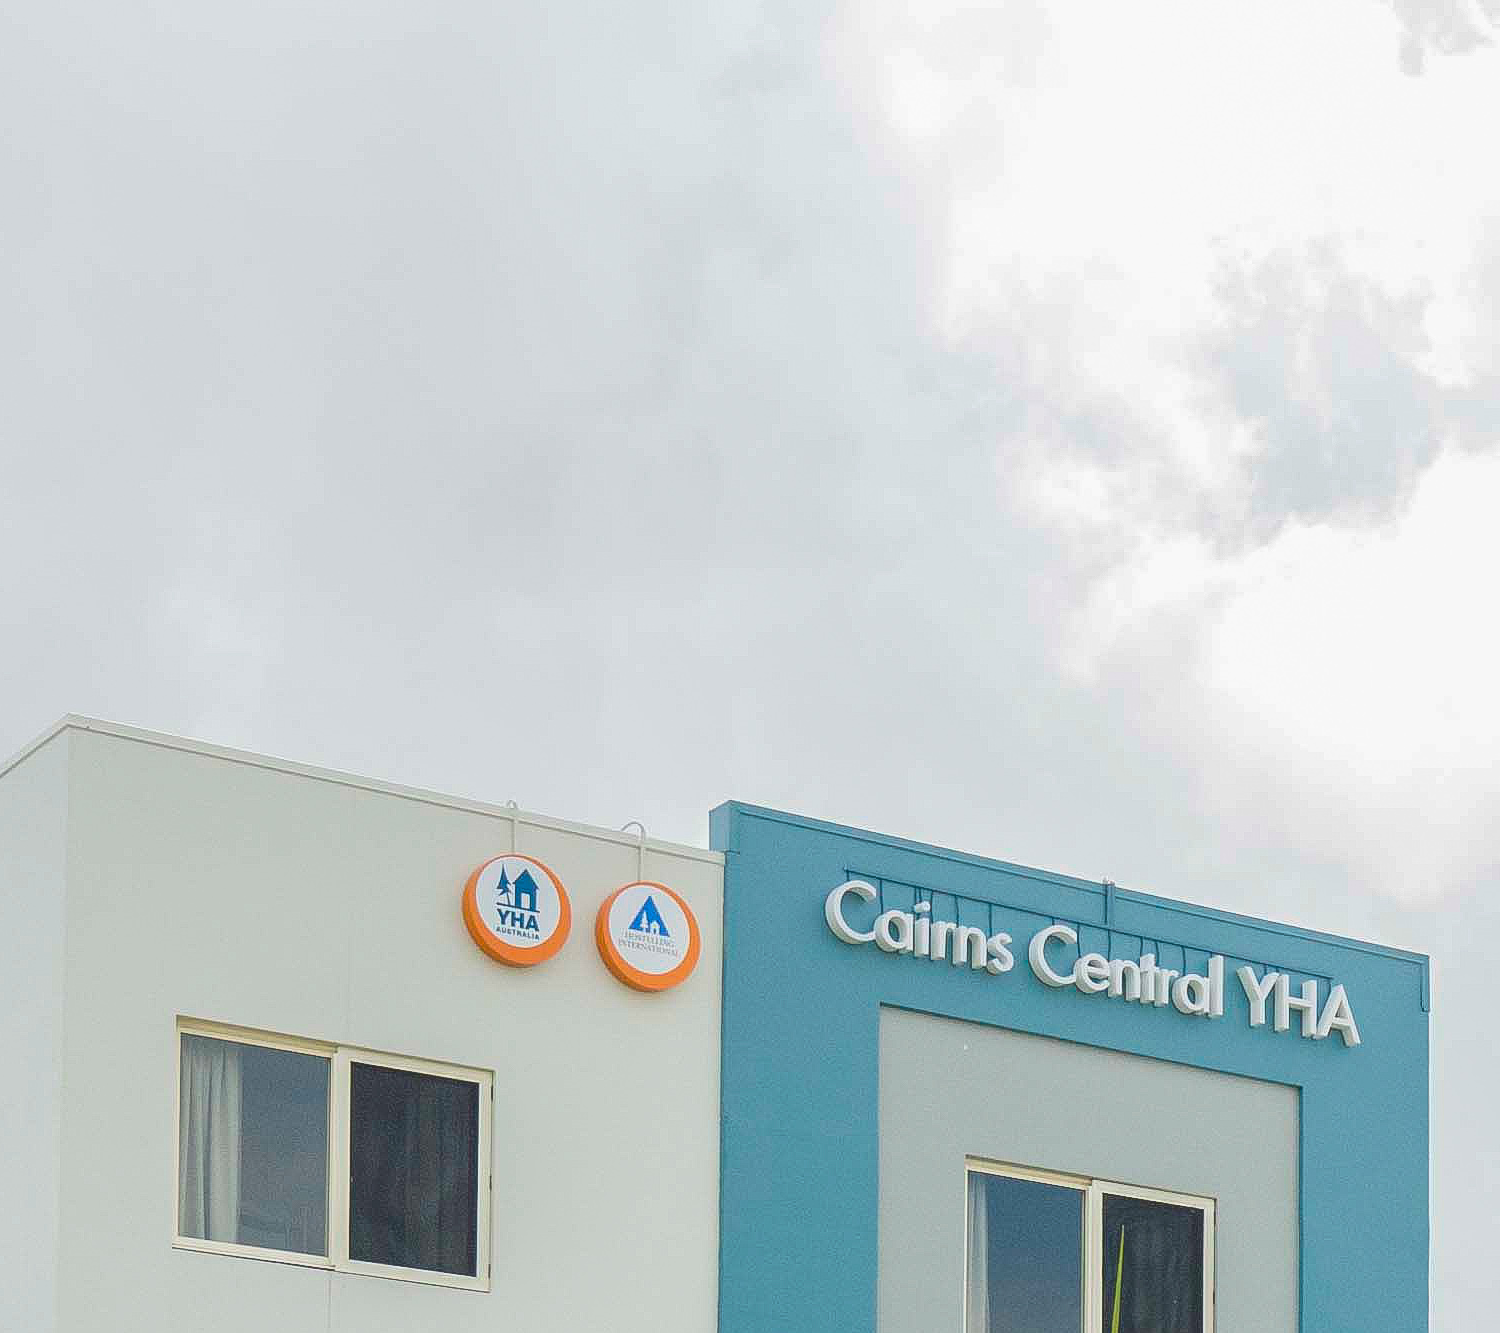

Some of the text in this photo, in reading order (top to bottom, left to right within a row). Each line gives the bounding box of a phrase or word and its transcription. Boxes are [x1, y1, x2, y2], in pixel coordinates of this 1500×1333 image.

[496, 907, 540, 932] YHA
[496, 927, 540, 941] AUSTRALIA
[824, 879, 1362, 1047] Cairns Central YHA
